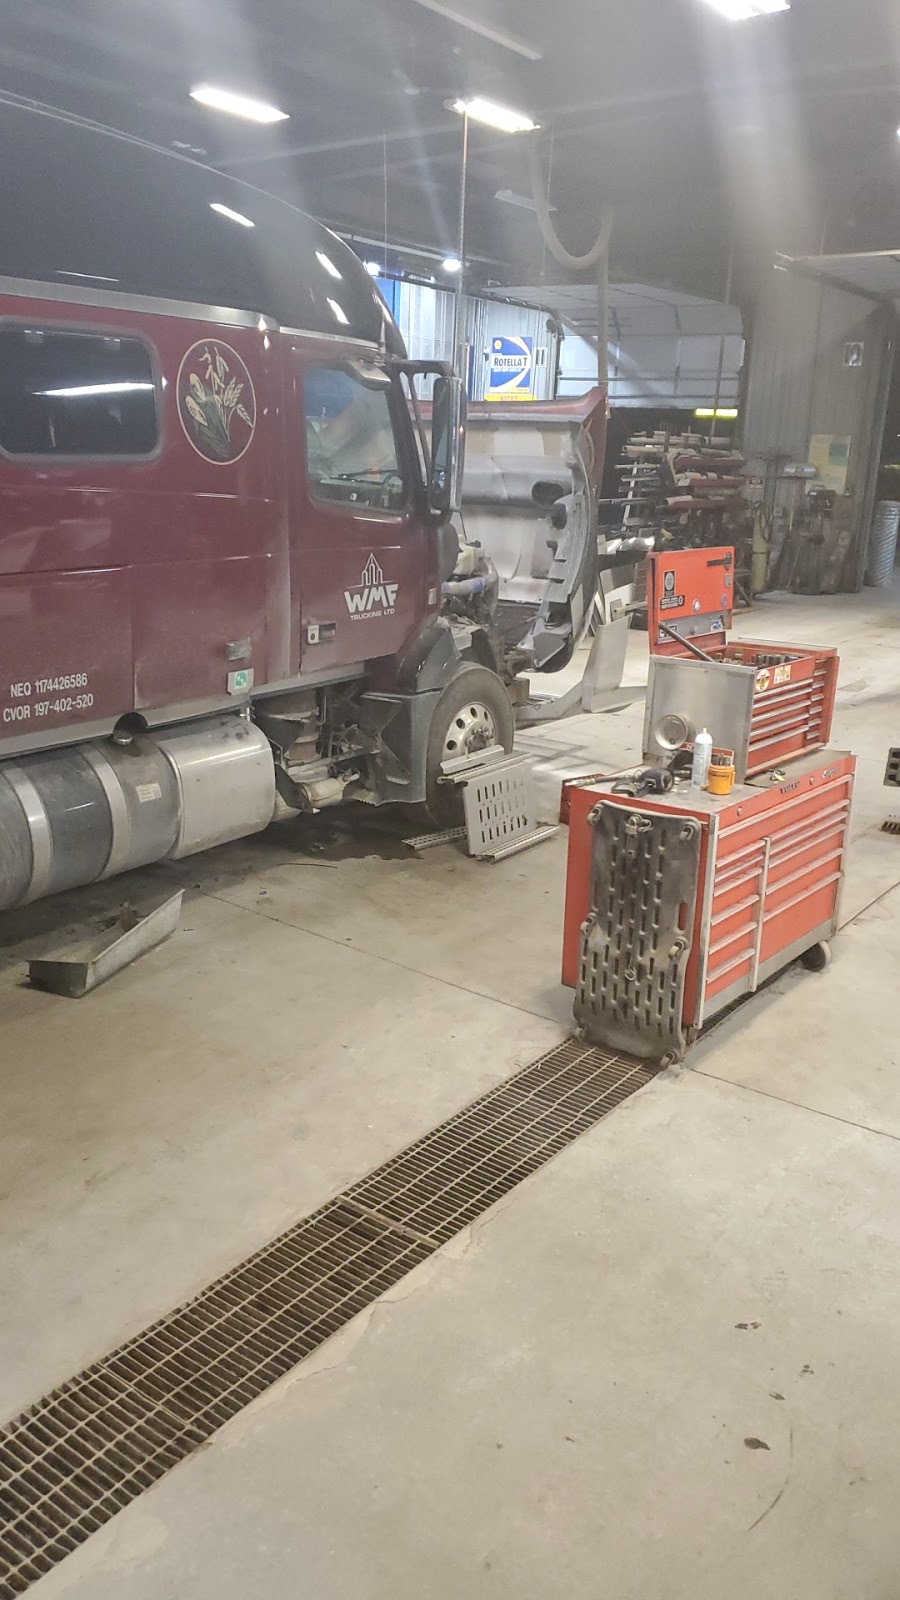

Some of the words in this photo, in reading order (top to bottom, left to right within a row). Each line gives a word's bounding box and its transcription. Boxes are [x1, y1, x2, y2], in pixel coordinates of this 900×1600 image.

[494, 357, 522, 366] ROTELLA
[523, 357, 528, 366] T
[343, 584, 399, 613] WMF
[350, 610, 382, 621] TRUCKING
[383, 608, 395, 616] LTD
[10, 682, 32, 698] NEQ
[35, 672, 88, 693] 1174426586
[3, 705, 31, 722] CVOR
[34, 693, 94, 716] 197-402-520
